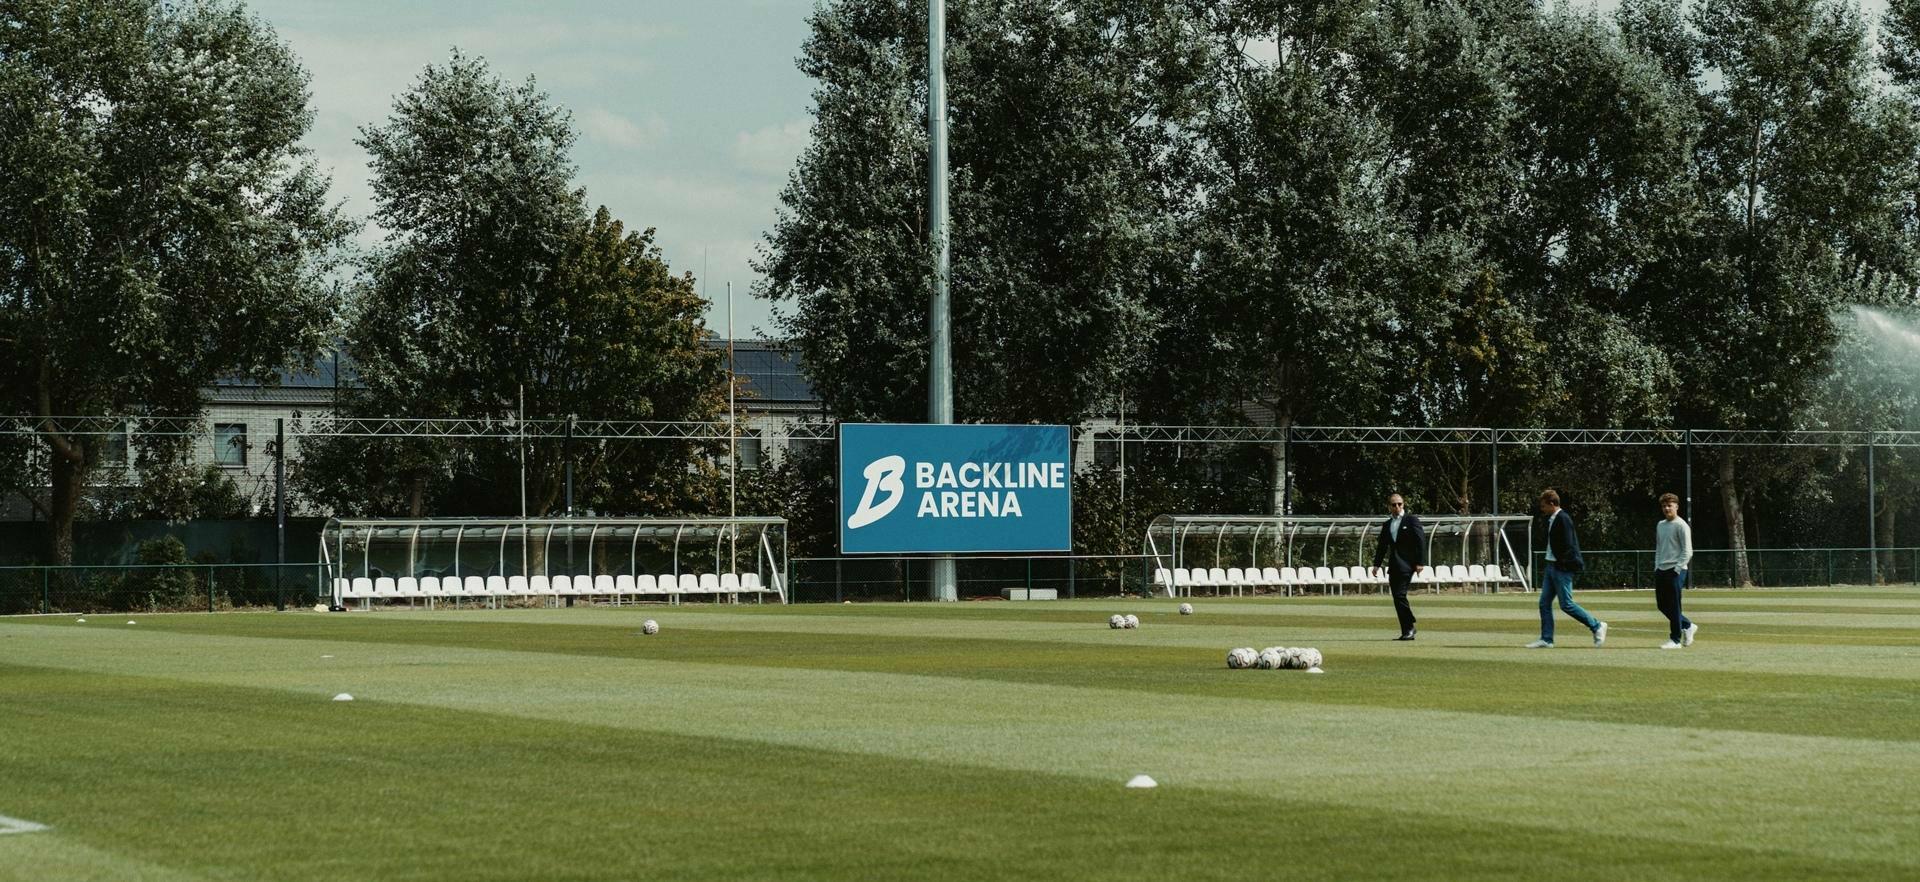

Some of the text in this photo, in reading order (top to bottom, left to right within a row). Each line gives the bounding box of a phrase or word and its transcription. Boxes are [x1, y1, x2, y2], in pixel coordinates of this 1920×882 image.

[916, 462, 1065, 488] BACKLINE
[848, 455, 906, 529] B
[917, 492, 1023, 517] ARENA
